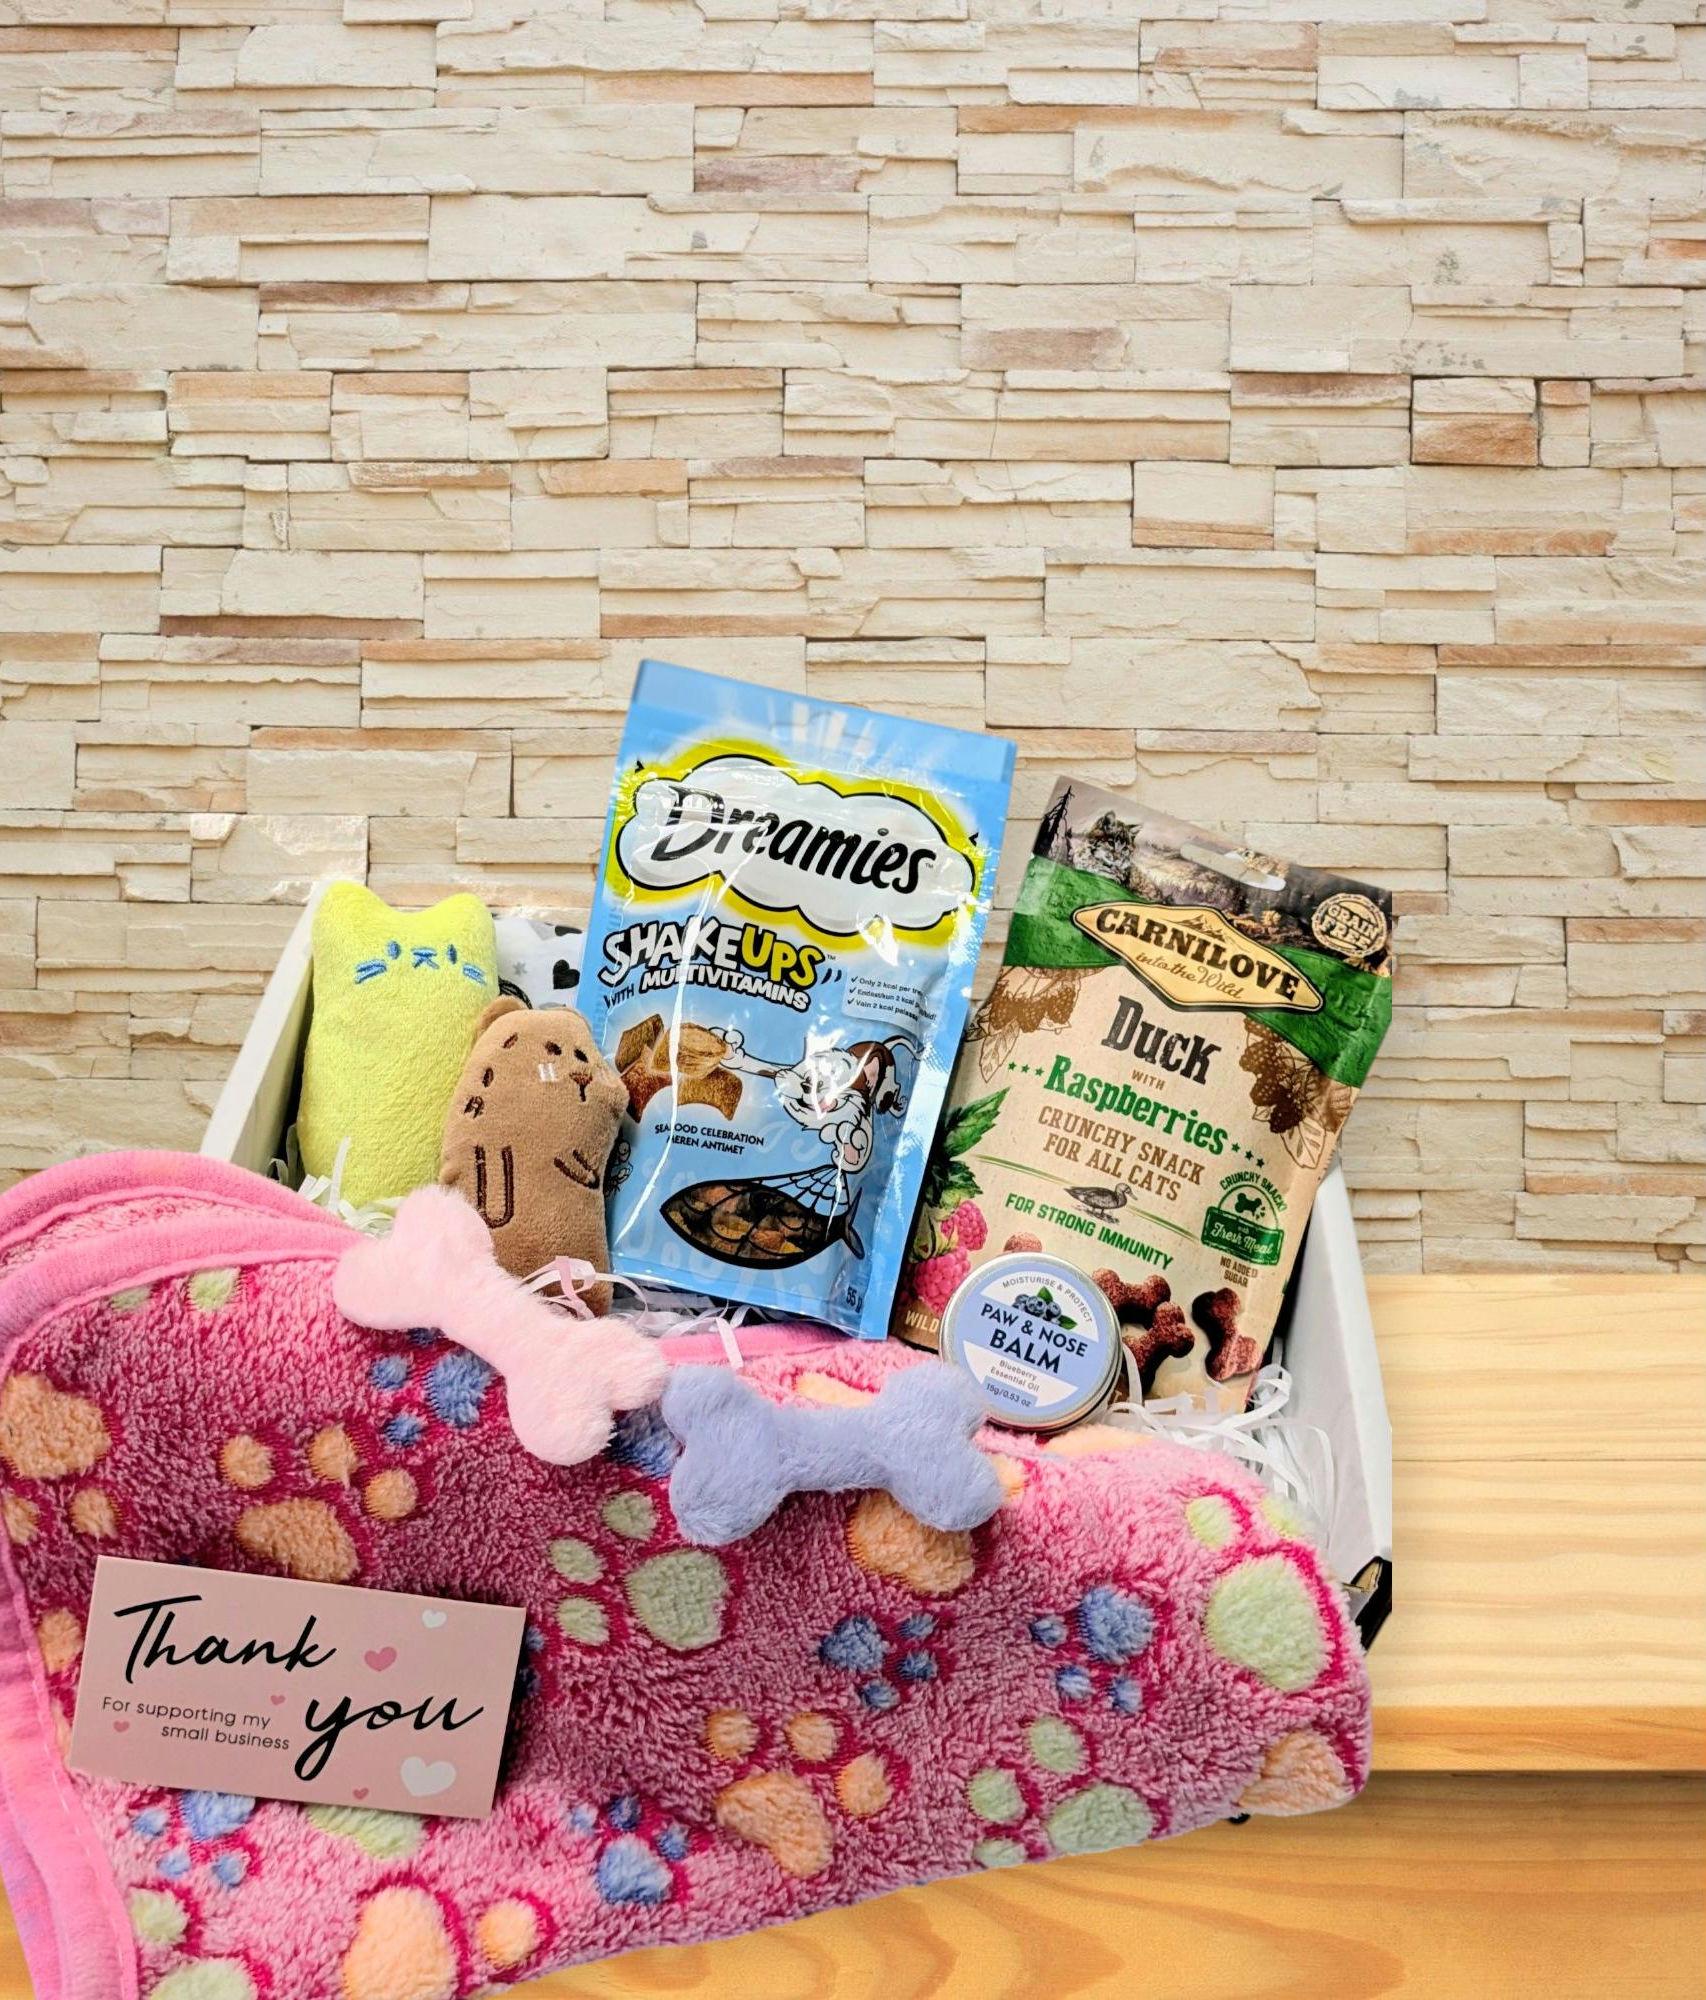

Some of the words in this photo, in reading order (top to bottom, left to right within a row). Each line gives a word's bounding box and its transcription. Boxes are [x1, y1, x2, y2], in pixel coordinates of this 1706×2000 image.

[650, 785, 937, 895] Dreamies
[1321, 914, 1371, 951] FREE
[1328, 904, 1379, 940] GRAIN
[1096, 908, 1300, 1001] CARNILOVE
[604, 984, 635, 1009] WITH
[638, 965, 811, 1013] MULTIVITAMINS
[859, 977, 876, 988] Only
[1135, 953, 1171, 972] into
[1168, 963, 1197, 983] the
[1198, 965, 1243, 999] Wild
[856, 1000, 872, 1008] Vain
[879, 1003, 894, 1011] kcal
[901, 997, 915, 1006] kcal
[1101, 995, 1222, 1085] Duck
[1131, 1069, 1166, 1090] WITH
[1043, 1054, 1229, 1155] Raspberries
[655, 1123, 697, 1135] SEAOOD
[700, 1127, 765, 1147] CELEBRATION
[701, 1139, 745, 1156] ANTIMET
[1038, 1105, 1137, 1153] CRUNCHY
[1138, 1142, 1206, 1186] SNACK
[1043, 1132, 1082, 1163] FOR
[1085, 1149, 1124, 1178] ALL
[1127, 1164, 1182, 1201] CATS
[1220, 1171, 1261, 1190] CRUNCHY
[1005, 1193, 1036, 1214] FOR
[1037, 1204, 1097, 1237] STRONG
[1097, 1226, 1174, 1270] IMMUNITY
[1220, 1256, 1232, 1268] NO
[1232, 1261, 1259, 1278] ADDED
[1223, 1270, 1249, 1288] SUGAR
[847, 1287, 858, 1307] 55
[1002, 1276, 1056, 1288] MOISTURISE
[1064, 1288, 1093, 1323] PROTECT
[905, 1310, 940, 1333] WILD
[980, 1303, 1019, 1327] PAW
[1021, 1320, 1034, 1336] &
[1038, 1327, 1089, 1358] NOSE
[989, 1329, 1061, 1374] BALM
[990, 1367, 1026, 1387] Essential
[1027, 1382, 1040, 1392] Oil
[1000, 1360, 1038, 1381] Blueberry
[1021, 1399, 1032, 1407] oz
[113, 1595, 338, 1684] Thank
[102, 1697, 131, 1713] For
[136, 1700, 237, 1728] supporting
[242, 1713, 272, 1729] my
[160, 1725, 210, 1743] small
[215, 1729, 290, 1751] business
[293, 1694, 485, 1782] you
